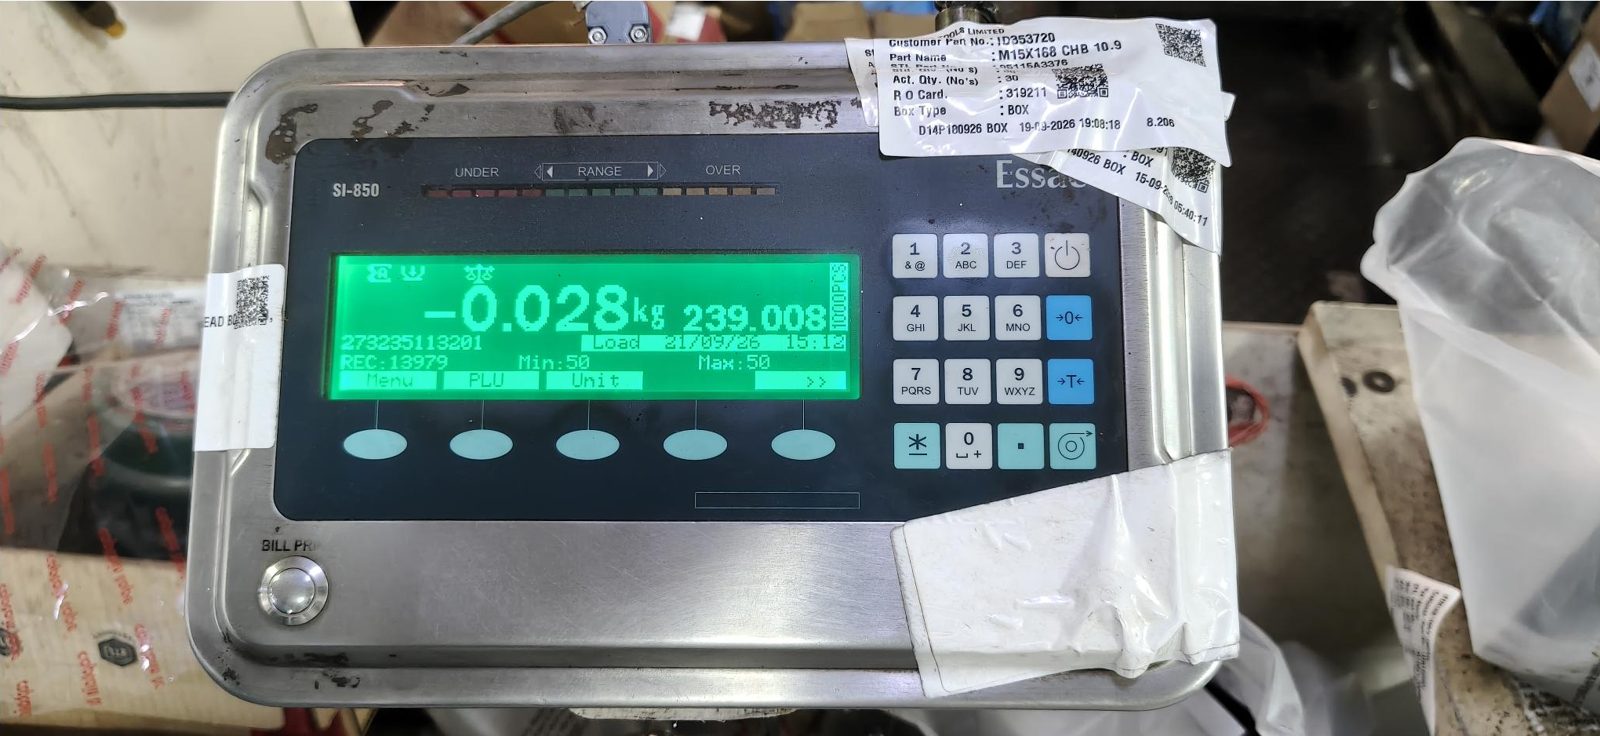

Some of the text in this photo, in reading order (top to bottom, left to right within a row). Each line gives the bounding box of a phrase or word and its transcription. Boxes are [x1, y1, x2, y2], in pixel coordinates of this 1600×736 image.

[939, 27, 964, 38] OOLS
[889, 39, 941, 47] Customer
[889, 53, 911, 61] Part
[916, 53, 947, 61] Name
[998, 46, 1057, 61] M15X168
[1061, 43, 1089, 56] CHB
[1094, 40, 1122, 52] 10.9
[892, 75, 915, 84] Act.
[919, 75, 942, 86] Qty.
[946, 75, 979, 86] (No's)
[893, 89, 901, 100] R
[917, 89, 948, 100] Card.
[1006, 87, 1047, 99] 319211
[894, 105, 915, 117] Box
[919, 105, 947, 118] Type
[1007, 104, 1029, 116] BOX
[918, 123, 983, 136] D14P180926
[986, 122, 1008, 133] BOX
[1079, 117, 1121, 130] 19:08:18
[1146, 117, 1175, 128] 8.206
[1131, 151, 1154, 167] BOX
[455, 164, 741, 178] UNDER RANGE OVER
[333, 183, 380, 197] SI-850
[1067, 148, 1101, 165] 40926
[1103, 159, 1126, 175] BOX
[1173, 200, 1208, 226] 05:40:11
[909, 242, 920, 256] 1
[960, 241, 971, 255] 2
[1011, 241, 1022, 255] 3
[955, 260, 977, 269] ABC
[1006, 260, 1027, 269] DEF
[424, 284, 827, 332] -0.028 kg 239.008
[910, 304, 921, 318] 4
[961, 304, 972, 317] 5
[1012, 303, 1023, 317] 6
[1064, 311, 1074, 324] 0
[906, 323, 925, 332] GHI
[957, 323, 976, 332] JKL
[1005, 323, 1031, 332] MNO
[341, 334, 845, 350] 273235113201 Load 21/09/26 15:12
[340, 354, 770, 370] REC:13979 Min:50 Max:50
[367, 373, 413, 387] Menu
[469, 372, 505, 388] PLU
[571, 372, 619, 388] Unit
[911, 368, 921, 381] 7
[962, 367, 973, 381] 8
[1014, 367, 1025, 381] 9
[1066, 374, 1077, 388] T
[901, 386, 931, 396] PQRS
[957, 386, 979, 396] TUV
[1004, 386, 1036, 396] WXYZ
[963, 432, 974, 445] 0
[262, 539, 291, 552] BILL
